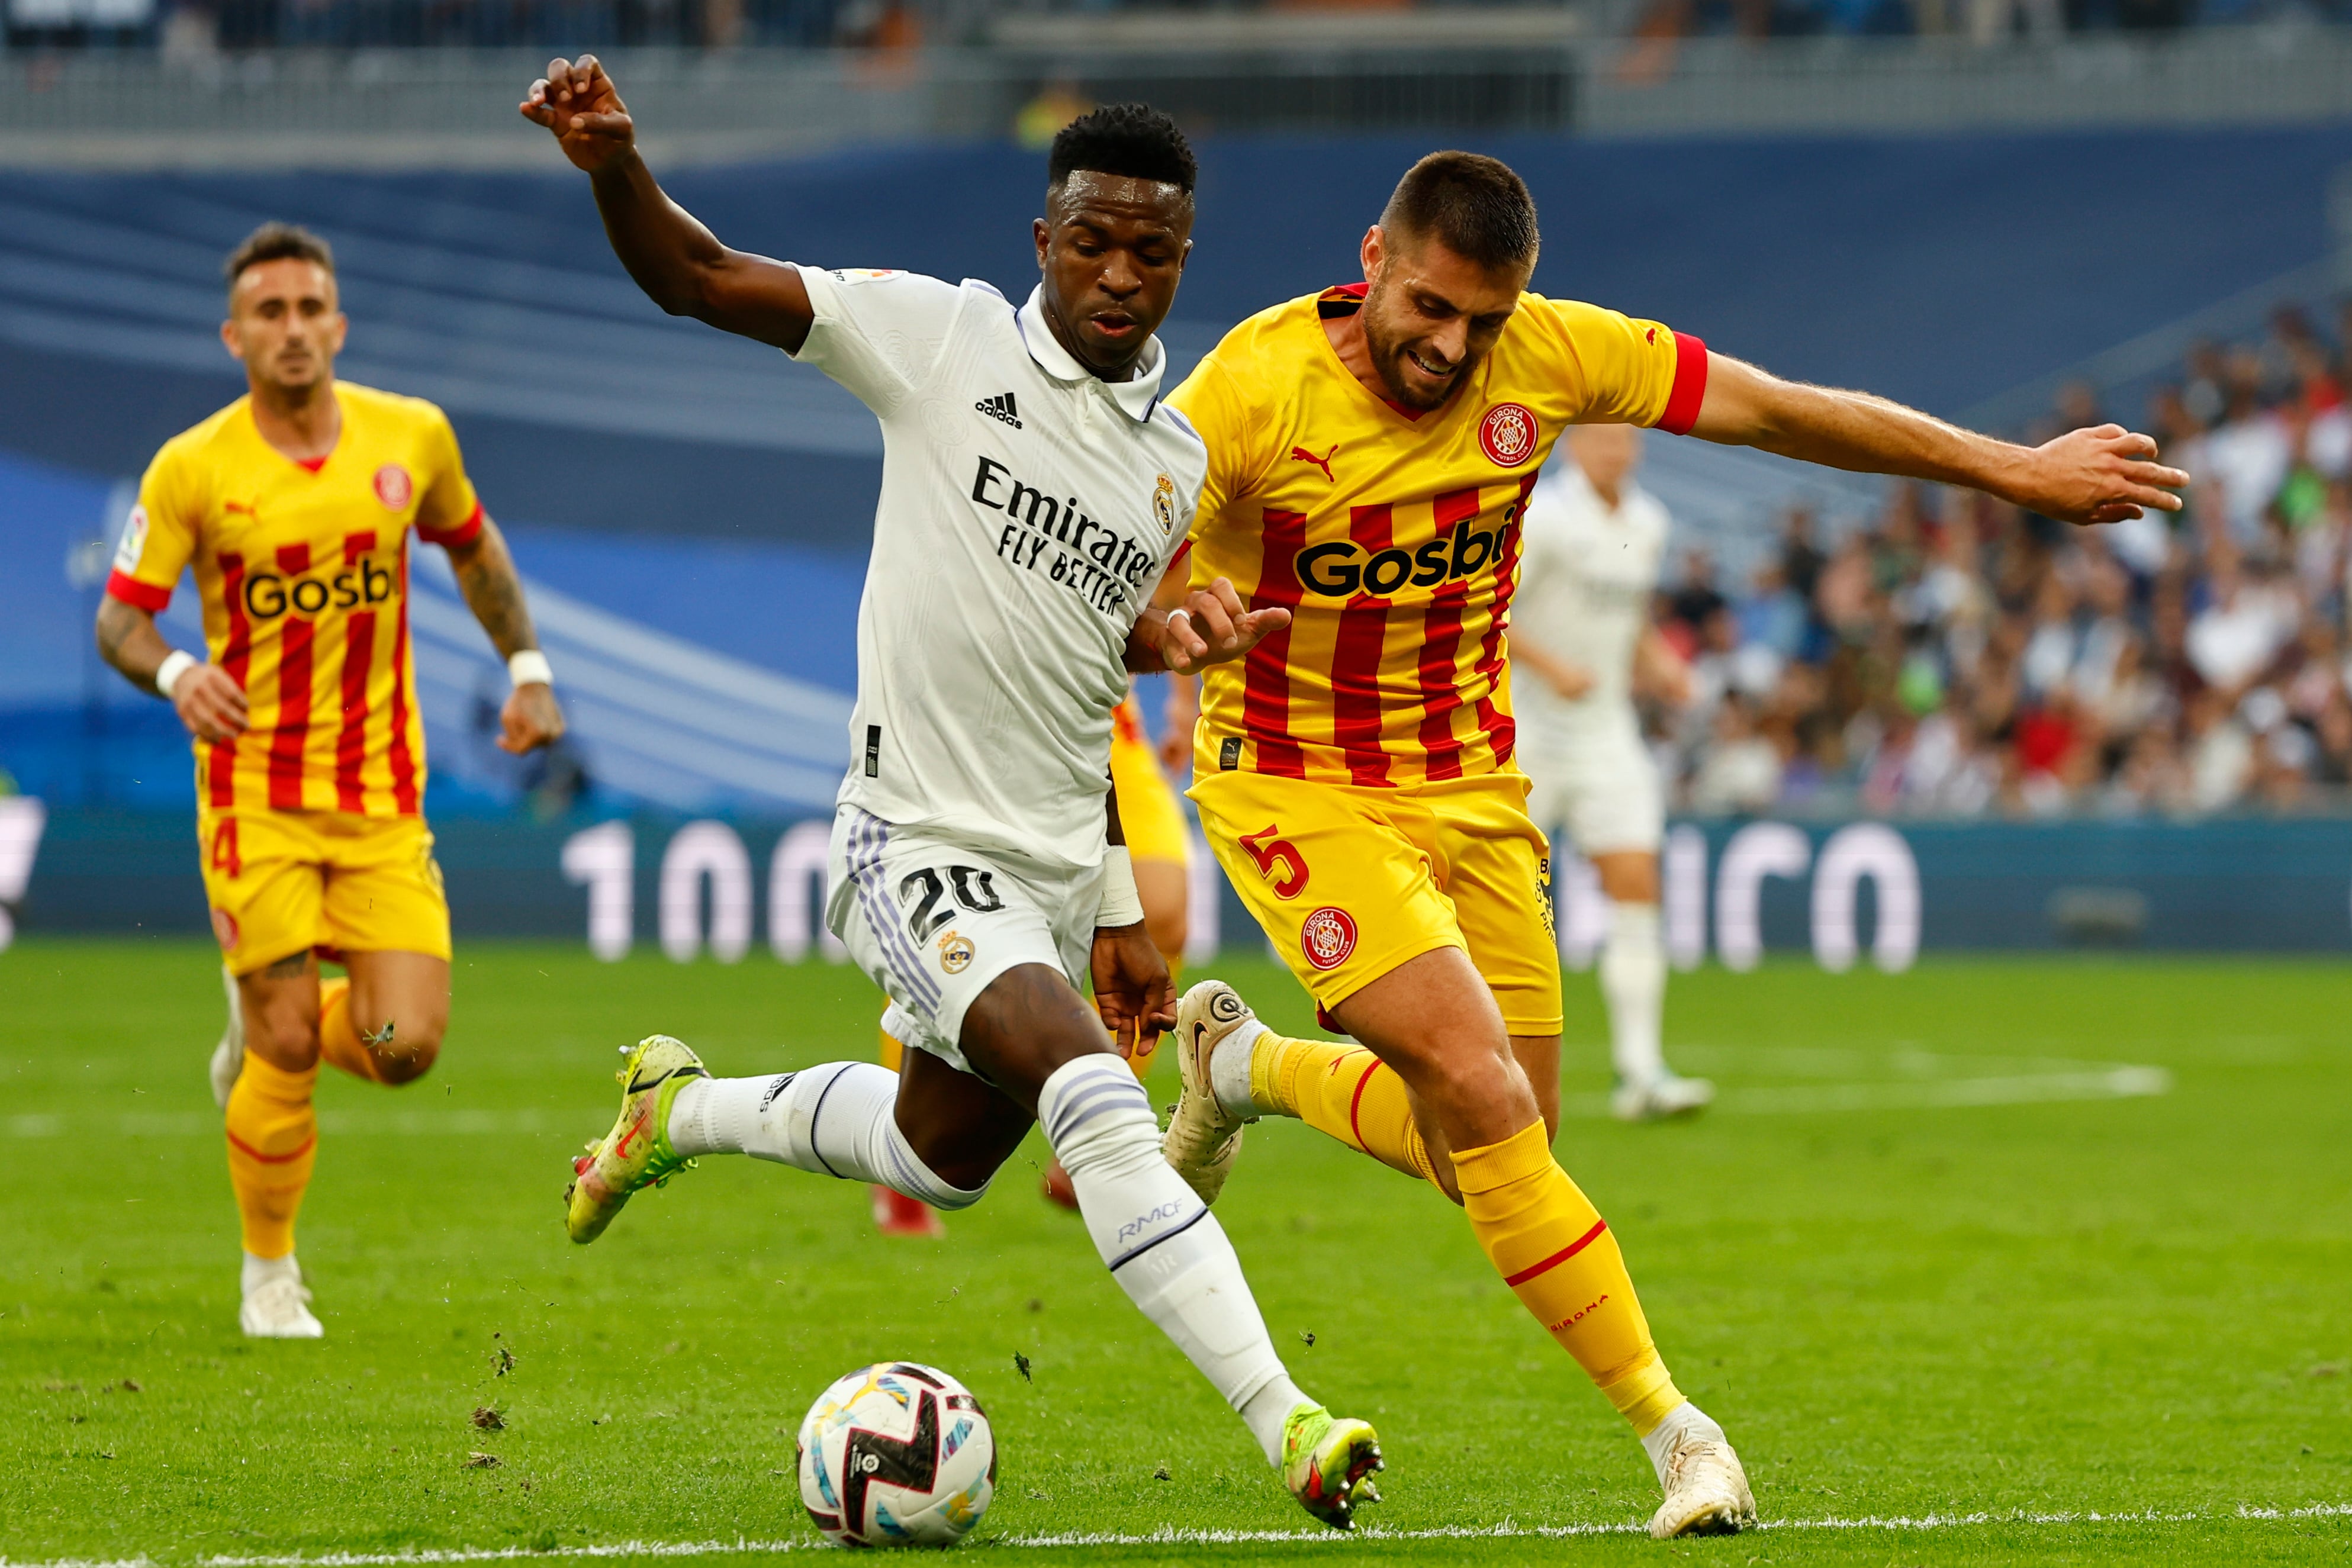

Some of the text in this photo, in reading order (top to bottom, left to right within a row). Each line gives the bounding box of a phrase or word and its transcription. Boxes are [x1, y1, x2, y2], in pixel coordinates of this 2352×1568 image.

[974, 401, 1023, 430] adidas
[1488, 407, 1524, 425] GIRONA
[1496, 445, 1529, 461] FUTBOL CLUB
[997, 524, 1125, 616] FLY BETTER
[1296, 506, 1517, 597] Gosbi
[213, 817, 242, 880] 4
[1237, 823, 1310, 901] 5
[897, 865, 1006, 951] 20
[1306, 912, 1335, 936] GIRONA
[1322, 941, 1350, 964] FUTBOL CLUB
[1118, 1197, 1183, 1244] RMCF
[1550, 1294, 1609, 1331] GIRONA
